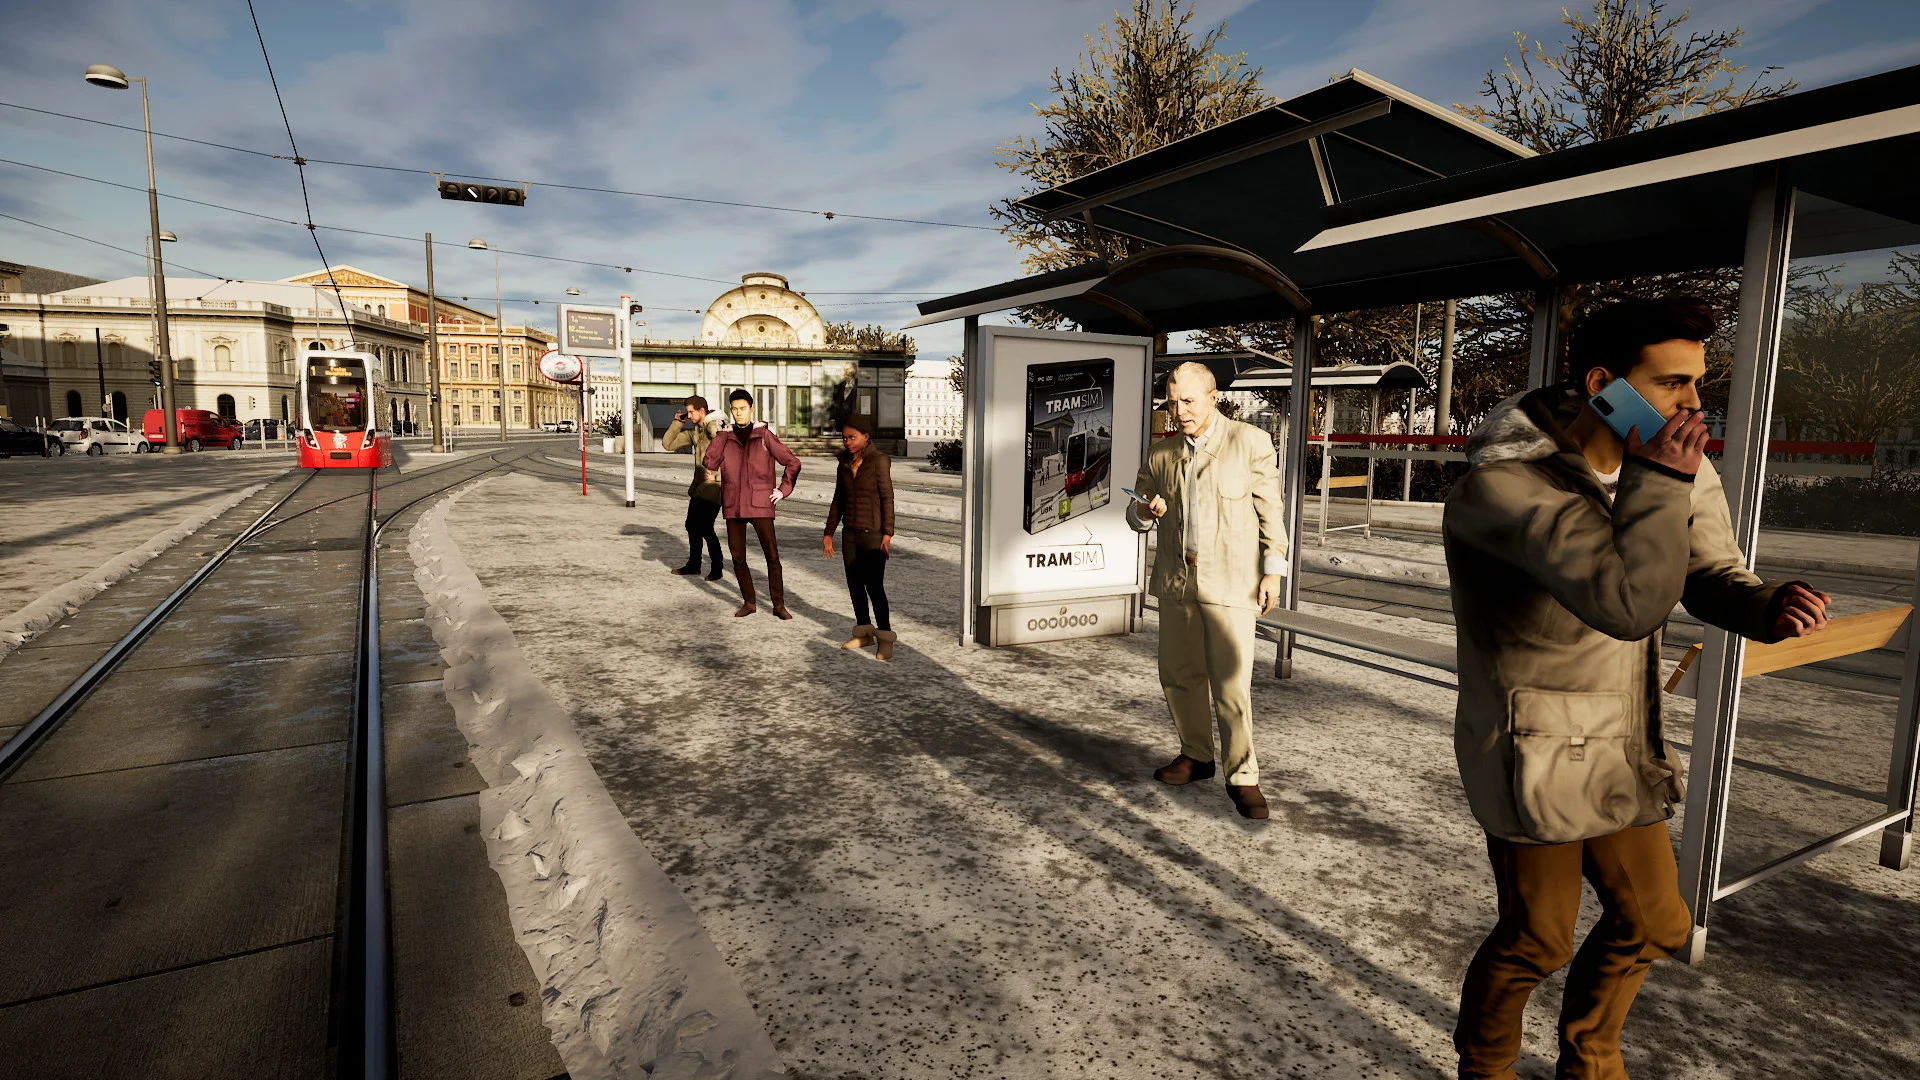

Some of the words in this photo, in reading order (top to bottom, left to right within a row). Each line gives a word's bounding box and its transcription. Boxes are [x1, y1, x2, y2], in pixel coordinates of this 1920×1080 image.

[310, 365, 316, 376] 1
[1045, 392, 1100, 414] TRAMSIM
[1041, 505, 1053, 515] USK
[1062, 501, 1068, 513] 3
[1025, 550, 1098, 568] TRAMSIM
